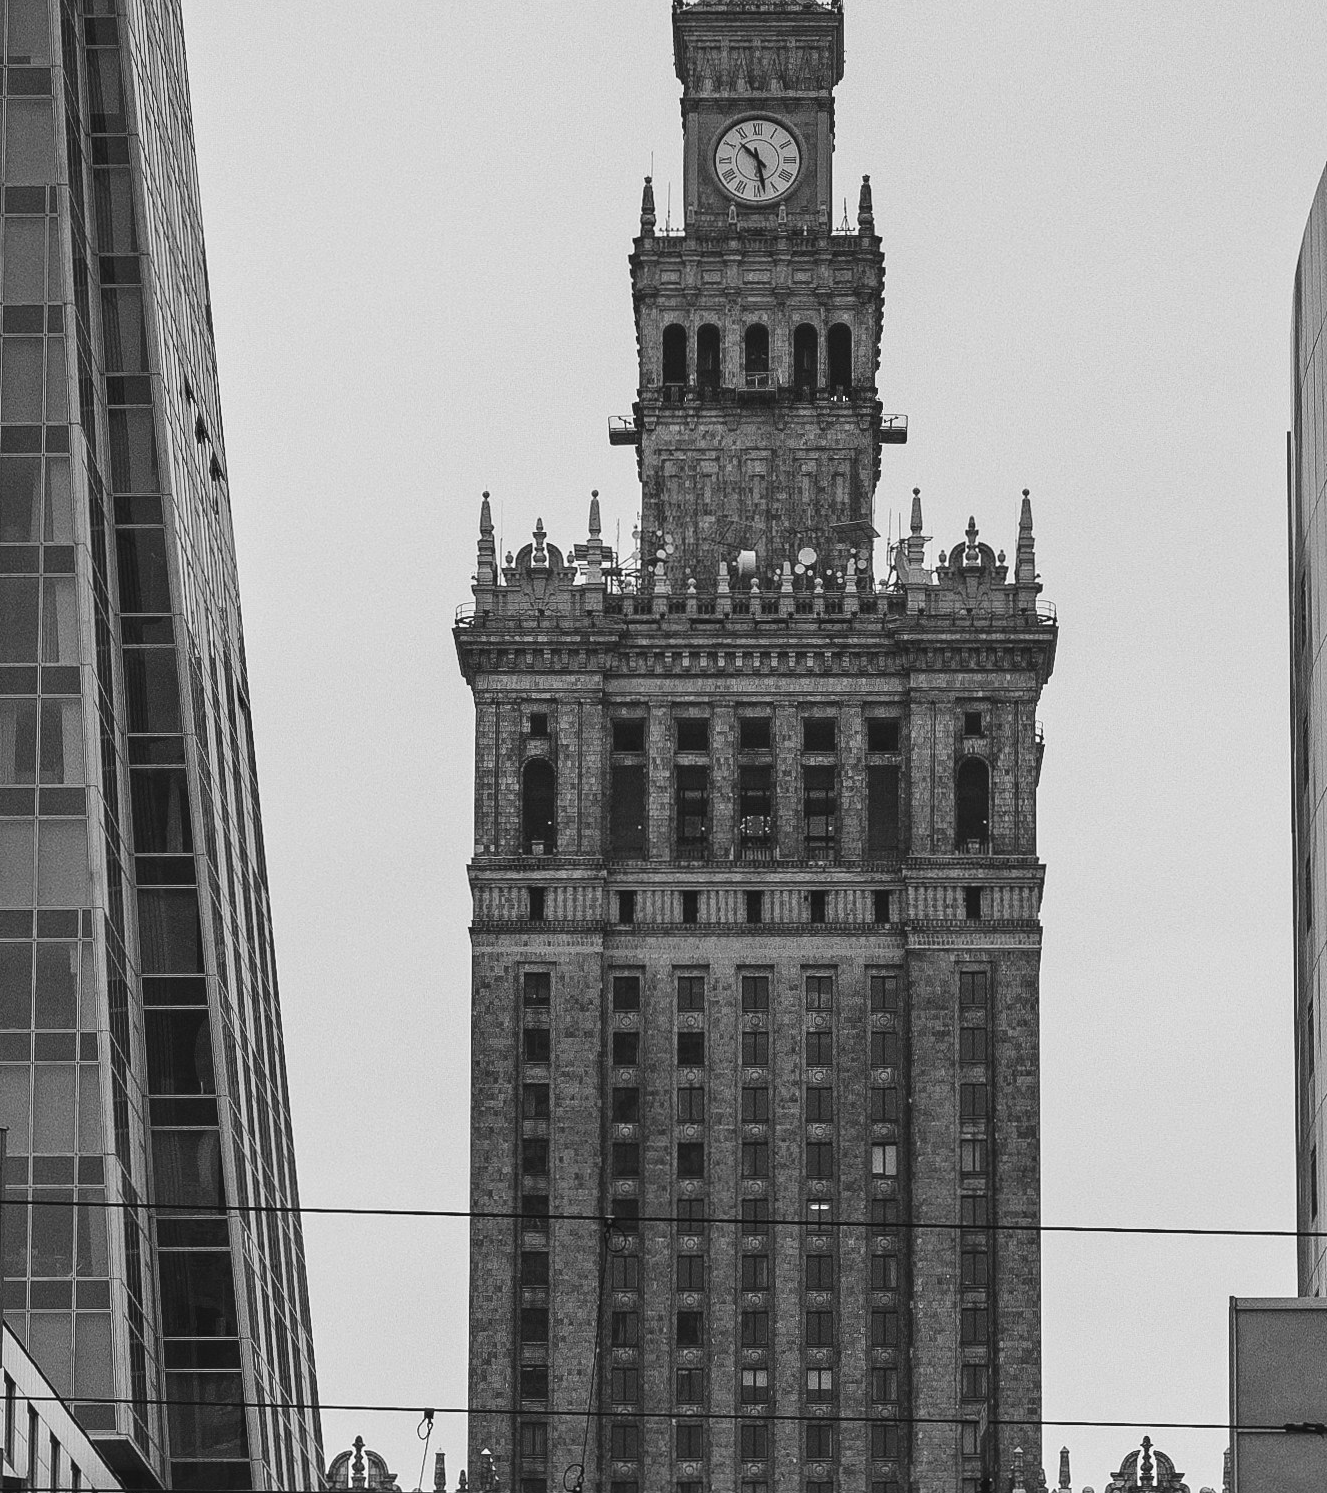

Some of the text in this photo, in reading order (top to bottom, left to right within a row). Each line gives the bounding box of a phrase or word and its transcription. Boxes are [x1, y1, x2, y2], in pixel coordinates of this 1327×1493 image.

[735, 127, 748, 140] XI
[752, 123, 763, 136] XII
[770, 128, 778, 139] I
[723, 139, 736, 150] X
[779, 139, 792, 150] II
[719, 156, 732, 164] IX
[783, 156, 797, 164] III
[770, 181, 779, 193] V
